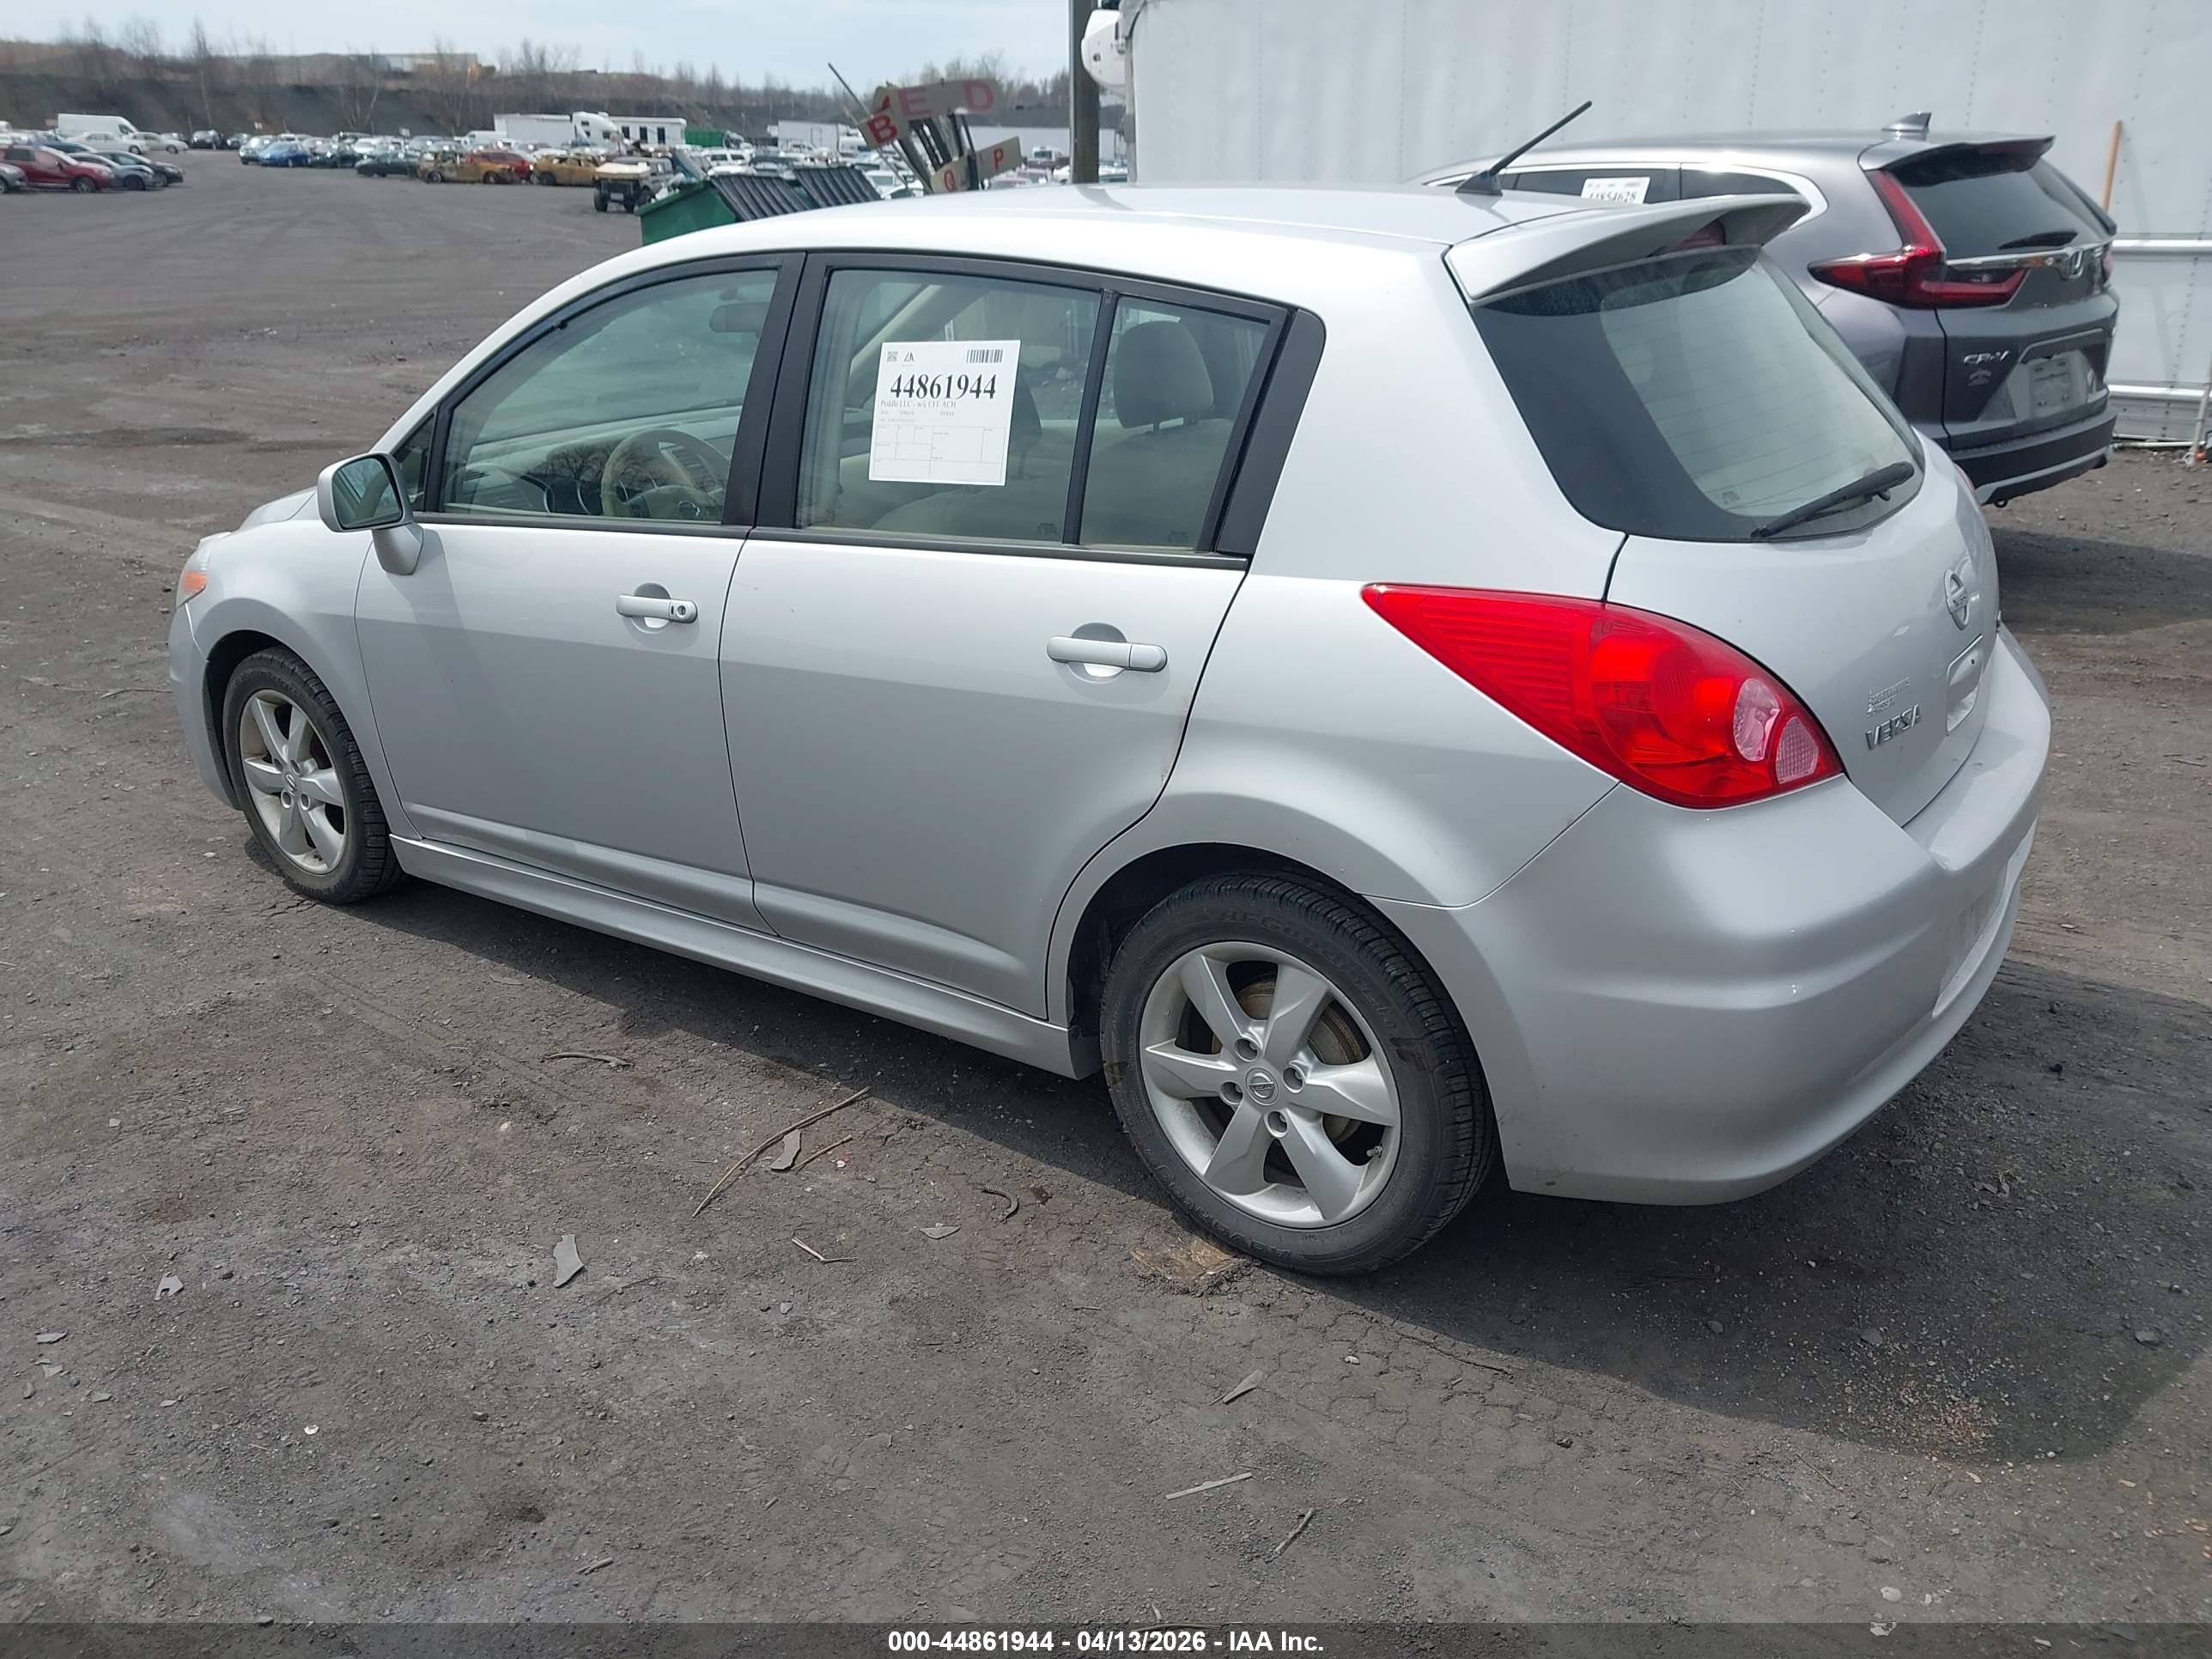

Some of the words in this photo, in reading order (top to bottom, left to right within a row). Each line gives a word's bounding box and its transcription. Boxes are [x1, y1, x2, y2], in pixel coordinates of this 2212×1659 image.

[897, 87, 933, 117] E
[963, 82, 994, 111] D
[867, 114, 898, 143] B
[994, 149, 1004, 170] P
[890, 374, 996, 398] 44861944
[1865, 703, 1921, 750] VERSA
